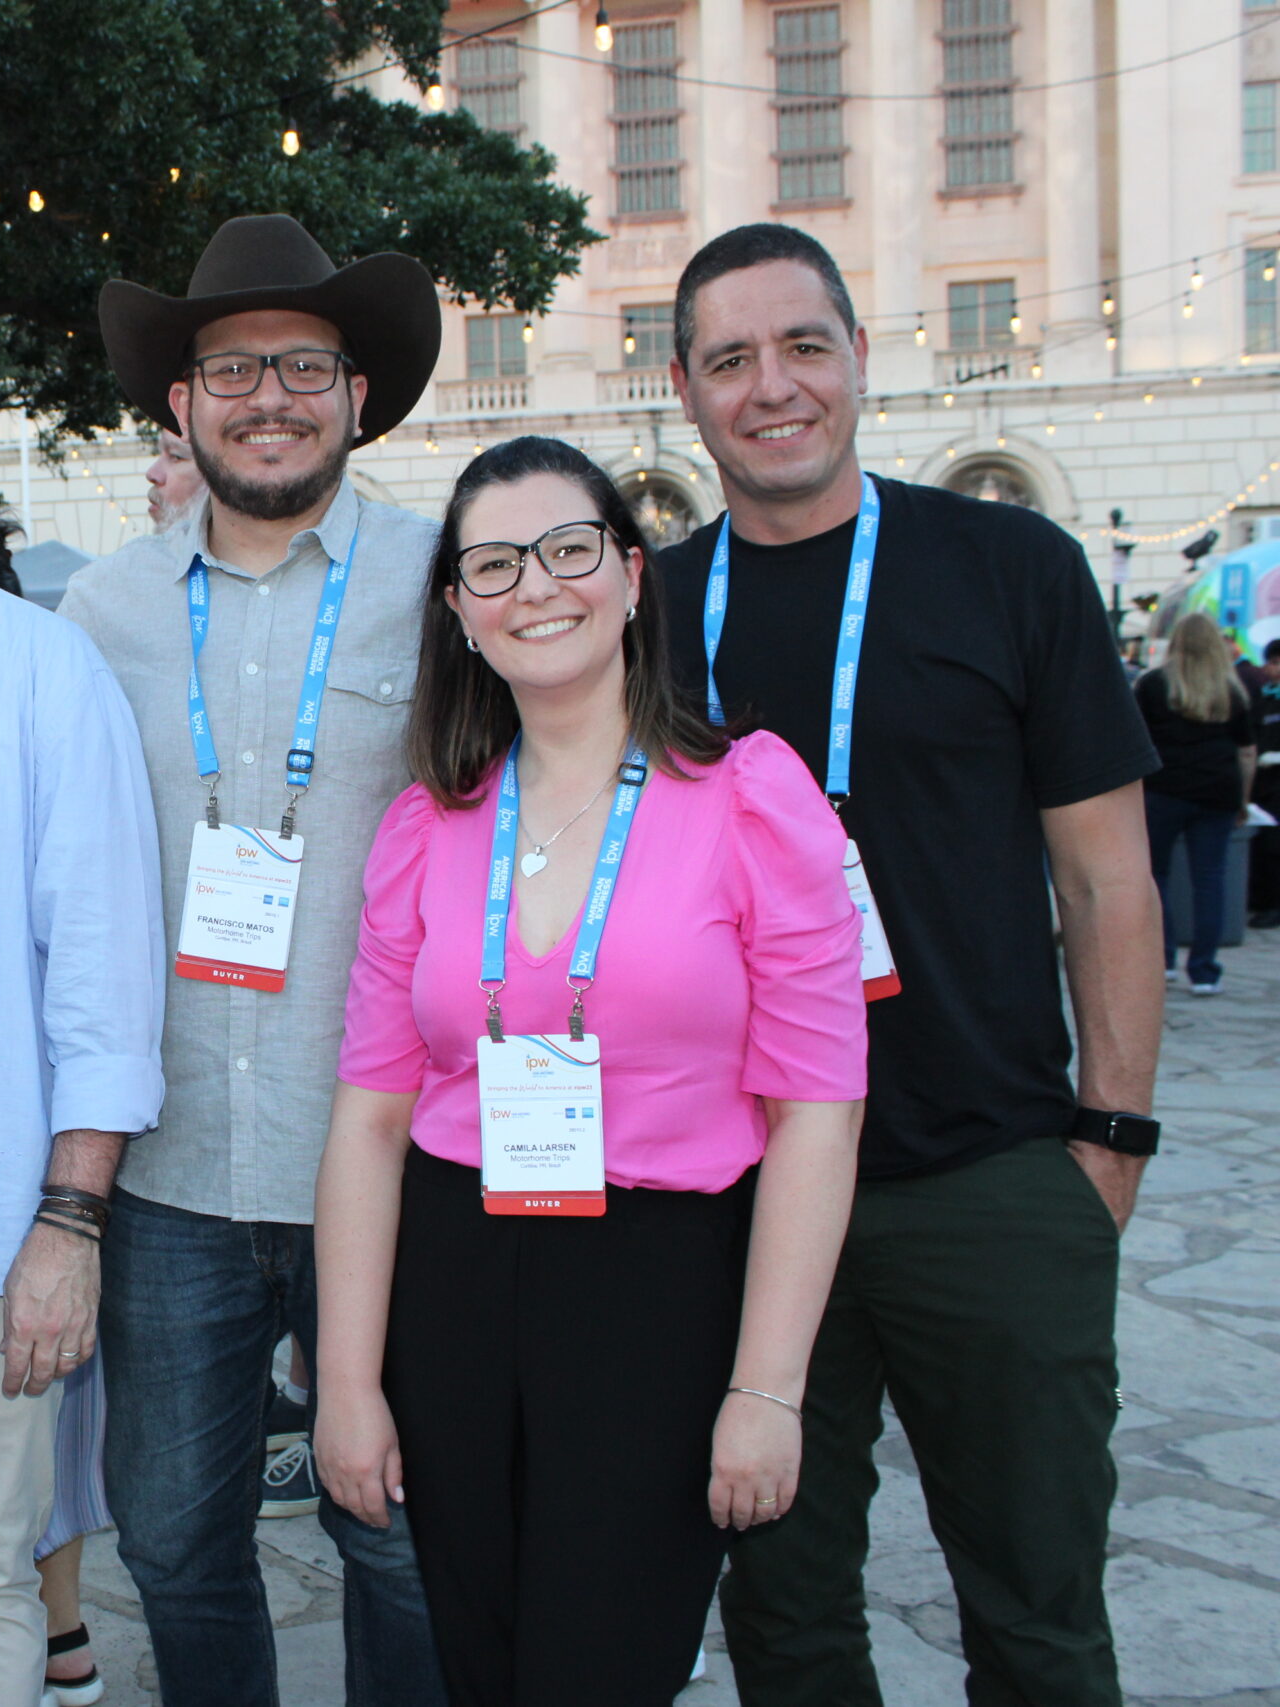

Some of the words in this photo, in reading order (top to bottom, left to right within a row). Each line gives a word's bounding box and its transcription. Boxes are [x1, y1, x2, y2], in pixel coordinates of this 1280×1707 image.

[862, 514, 878, 536] ipw
[850, 562, 862, 601] EXPRESS
[857, 558, 870, 602] AMERICAN
[192, 614, 206, 635] ipw
[318, 604, 336, 625] ipw
[846, 614, 863, 638] ipw
[308, 635, 324, 677] AMERICAN
[316, 636, 330, 672] EXPRESS
[836, 667, 846, 710] EXPRESS
[843, 661, 855, 710] AMERICAN
[193, 711, 205, 735] ipw
[299, 700, 317, 726] ipw
[833, 724, 850, 749] ipw
[499, 807, 516, 832] ipw
[235, 844, 259, 859] ipw
[601, 840, 620, 864] ipw
[195, 881, 216, 895] ipw
[490, 859, 500, 900] EXPRESS
[497, 855, 510, 901] AMERICAN
[587, 877, 605, 925] AMERICAN
[595, 878, 612, 920] EXPRESS
[197, 915, 245, 929] FRANCISCO
[246, 923, 275, 934] MATOS
[207, 926, 244, 938] Motorhome
[246, 931, 261, 941] Trips
[487, 913, 505, 937] ipw
[213, 970, 245, 980] BUYER
[571, 951, 591, 976] ipw
[526, 1054, 550, 1071] ipw
[490, 1107, 511, 1120] ipw
[503, 1144, 538, 1152] CAMILA
[539, 1143, 576, 1152] LARSEN
[510, 1154, 551, 1162] Motorhome
[552, 1153, 570, 1162] Trips
